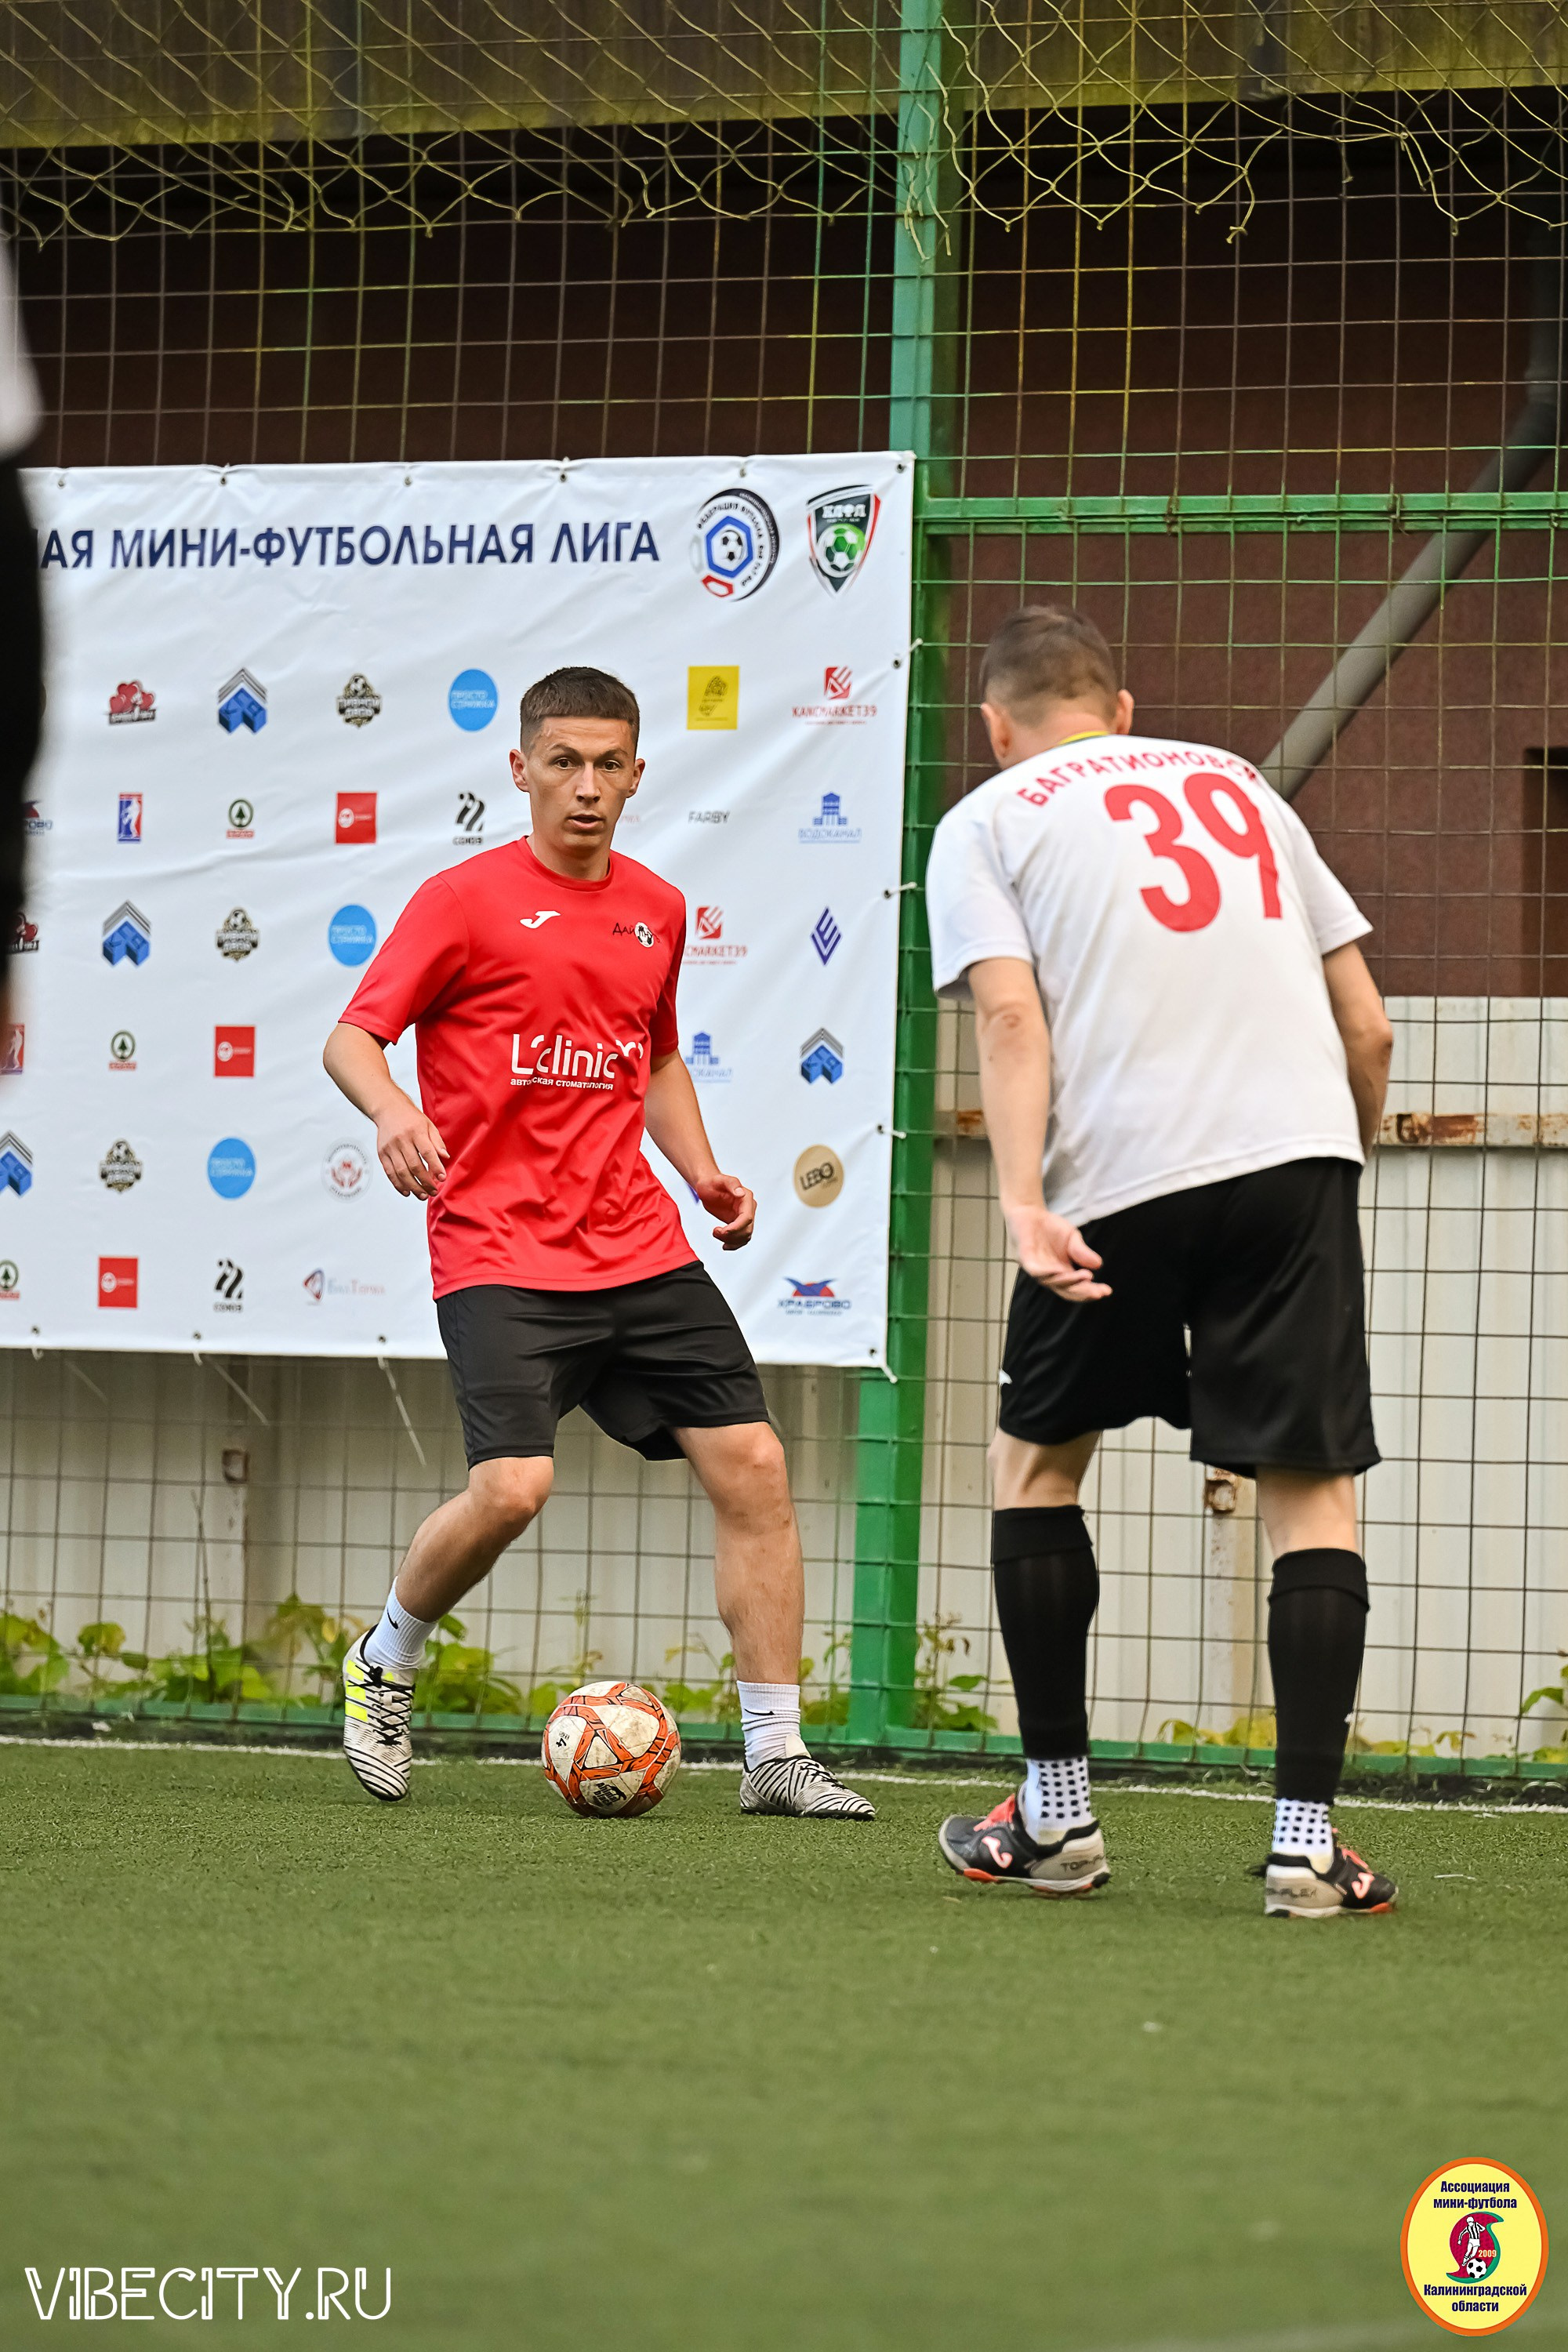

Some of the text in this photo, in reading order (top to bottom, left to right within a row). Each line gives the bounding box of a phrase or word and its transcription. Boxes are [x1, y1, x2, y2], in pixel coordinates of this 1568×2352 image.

[39, 521, 661, 569] АЯ МИНИ-ФУТБОЛЬНАЯ ЛИГА
[1104, 772, 1283, 933] 39
